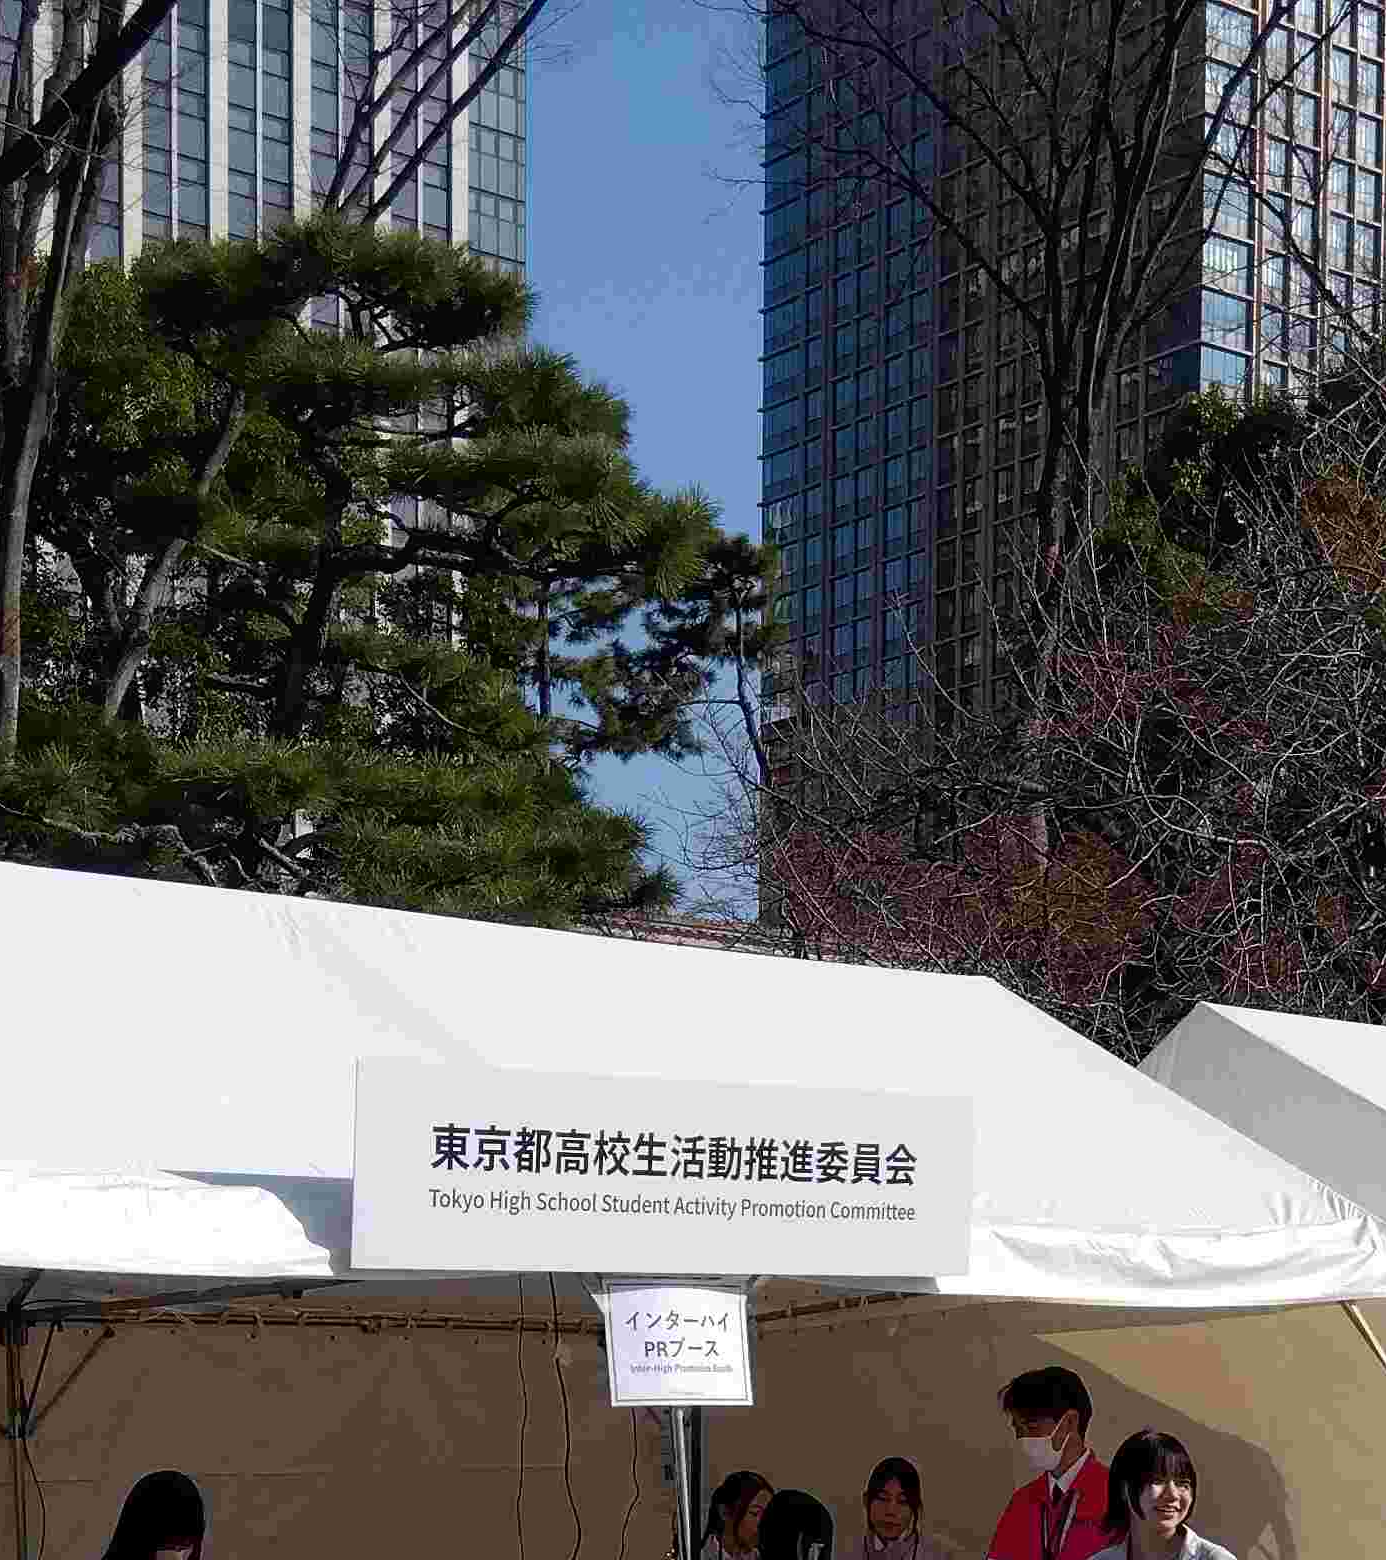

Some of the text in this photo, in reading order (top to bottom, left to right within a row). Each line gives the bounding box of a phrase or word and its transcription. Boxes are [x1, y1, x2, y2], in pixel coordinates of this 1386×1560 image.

[431, 1122, 917, 1186] 東京都高校生活動推進委員会
[429, 1188, 917, 1220] Tokyo High School Student Activity Promotion Committee
[625, 1310, 729, 1333] インターハイ
[644, 1336, 720, 1358] PRブース
